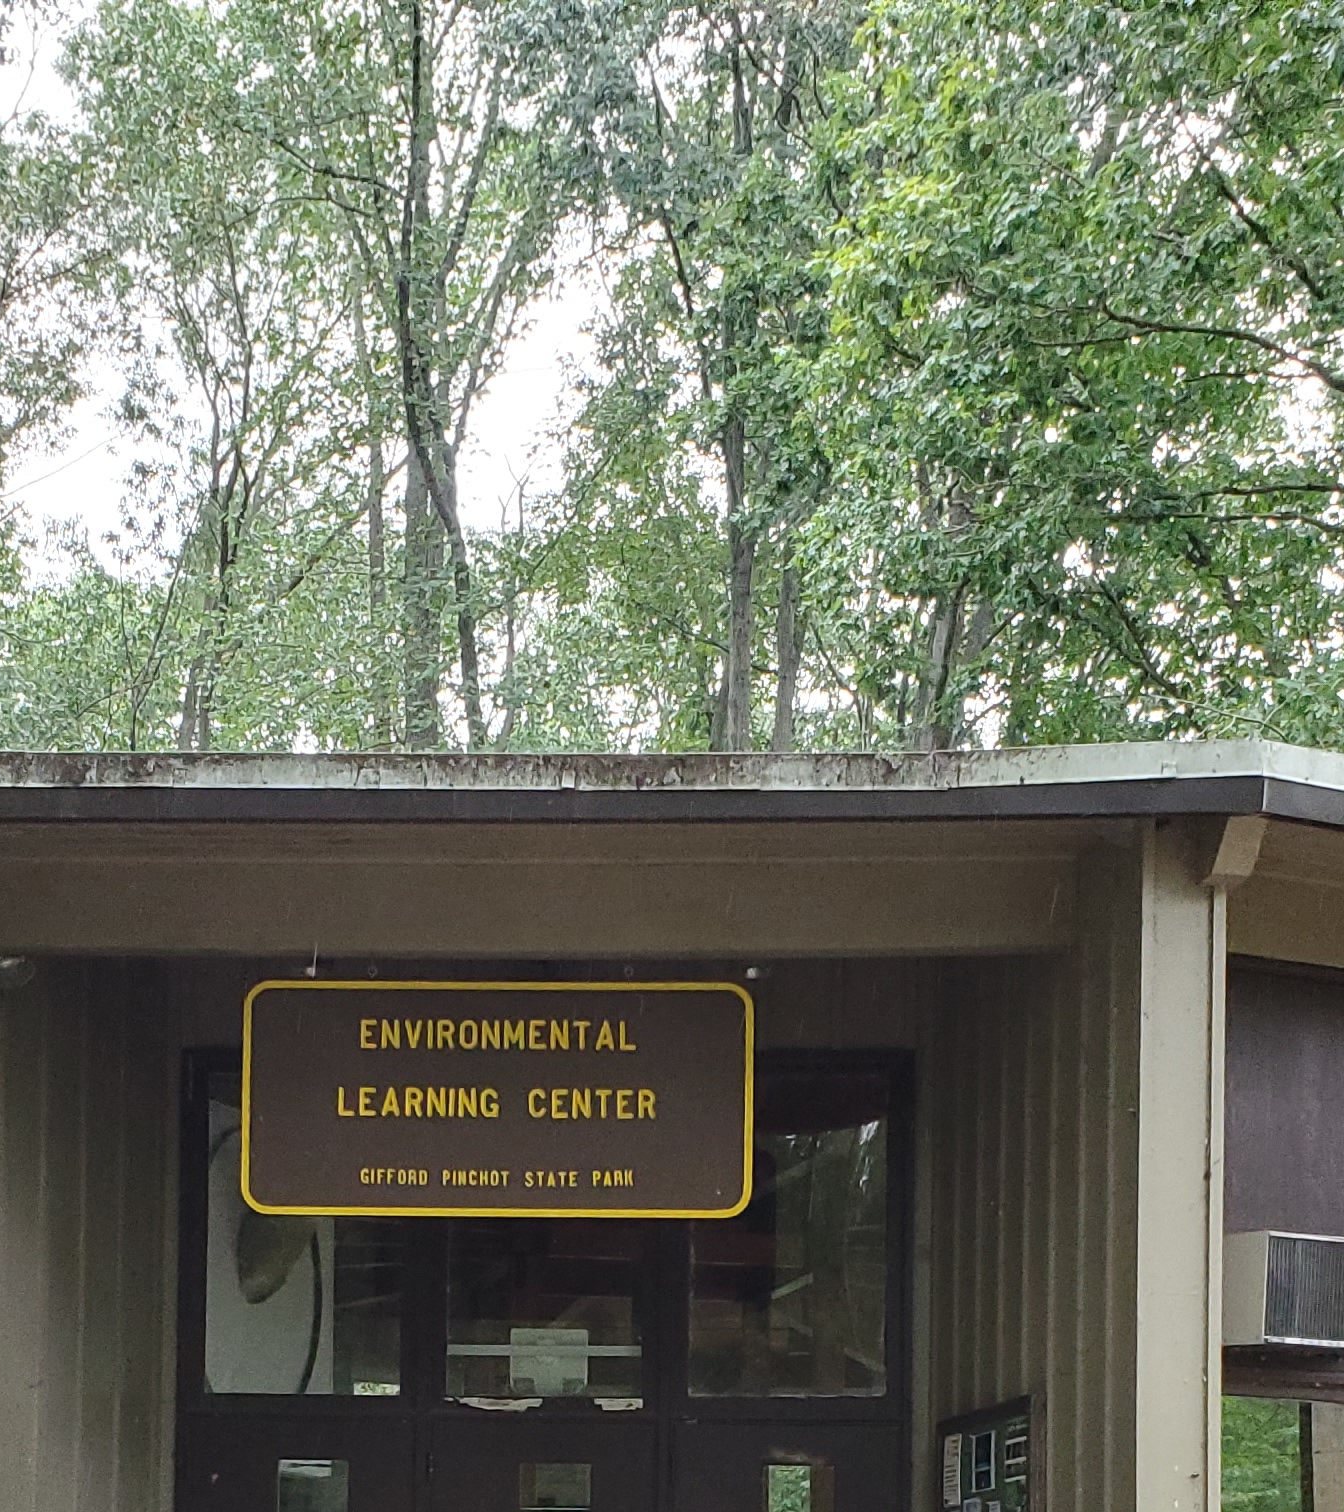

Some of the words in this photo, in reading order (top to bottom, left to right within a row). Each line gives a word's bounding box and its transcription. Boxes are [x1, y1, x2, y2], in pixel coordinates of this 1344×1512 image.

[359, 1018, 637, 1052] ENVIRONMENTAL
[337, 1086, 500, 1119] LEARNING
[527, 1088, 657, 1120] CENTER
[359, 1167, 428, 1186] GIFFORD
[442, 1169, 509, 1187] PINCHOT
[524, 1170, 578, 1188] STATE
[592, 1170, 634, 1188] PARK
